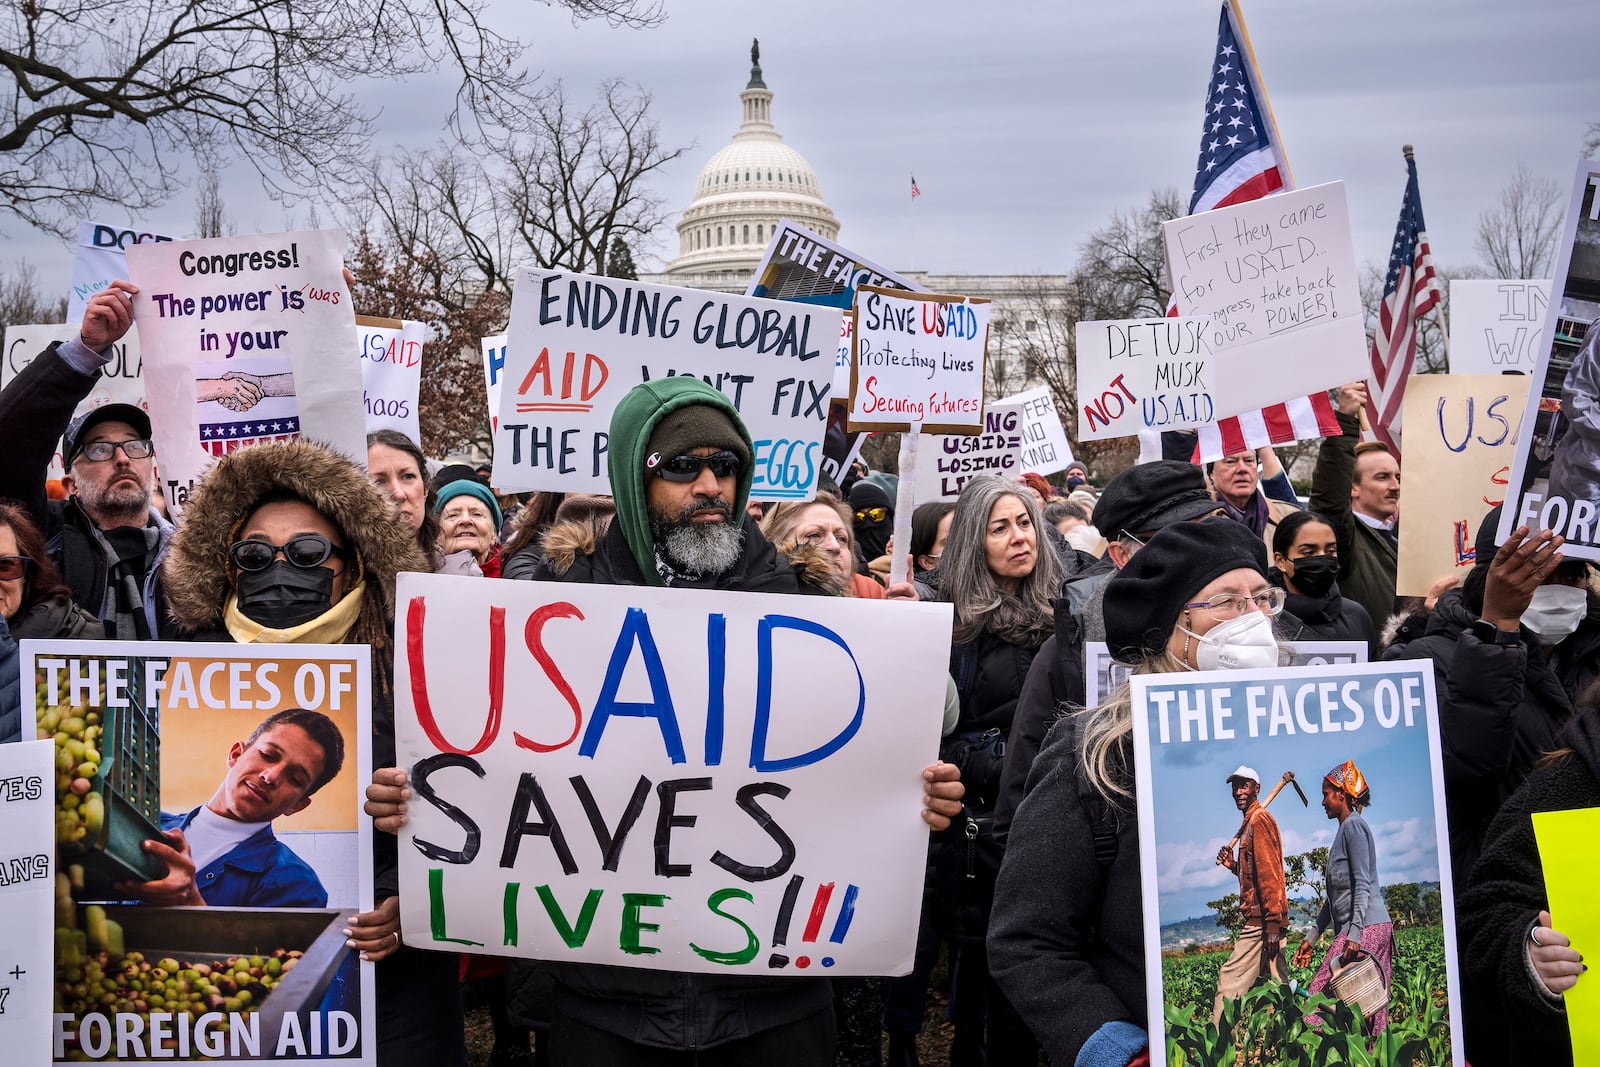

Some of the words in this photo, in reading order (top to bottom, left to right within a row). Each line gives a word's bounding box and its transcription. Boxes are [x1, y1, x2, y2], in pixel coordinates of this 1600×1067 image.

[179, 243, 300, 277] Congress!
[779, 229, 828, 273] THE
[1177, 225, 1223, 271] First
[1233, 217, 1273, 250] they
[1279, 203, 1328, 230] came
[152, 294, 195, 318] The
[200, 290, 272, 319] power
[308, 287, 341, 305] was
[1181, 275, 1214, 303] for
[1260, 280, 1292, 309] take
[1297, 267, 1336, 293] back
[1265, 290, 1338, 328] POWER!
[538, 274, 683, 338] ENDING
[693, 299, 820, 362] GLOBAL
[866, 294, 916, 335] SAVE
[922, 302, 978, 341] USAID
[1106, 320, 1213, 360] DETUSK
[200, 329, 219, 351] in
[226, 328, 288, 358] your
[859, 339, 936, 380] Protecting
[942, 351, 974, 372] Lives
[517, 347, 609, 401] AID
[771, 377, 831, 421] FIX
[1155, 361, 1206, 390] MUSK
[363, 390, 409, 418] haos
[862, 376, 924, 422] Securing
[929, 391, 978, 415] Futures
[1023, 396, 1053, 420] FER
[1083, 374, 1137, 432] NOT
[503, 424, 581, 475] THE
[751, 439, 819, 490] EGGS
[937, 454, 1015, 473] LOSING
[38, 658, 130, 708] THE
[145, 660, 282, 710] FACES
[293, 663, 352, 711] OF
[406, 595, 866, 773] USAID
[1149, 687, 1236, 744] THE
[1245, 679, 1365, 738] FACES
[1373, 677, 1422, 729] OF
[411, 752, 797, 883] SAVES
[428, 868, 860, 969] LIVES!!!
[53, 1011, 262, 1059] FOREIGN
[275, 1009, 360, 1058] AID
